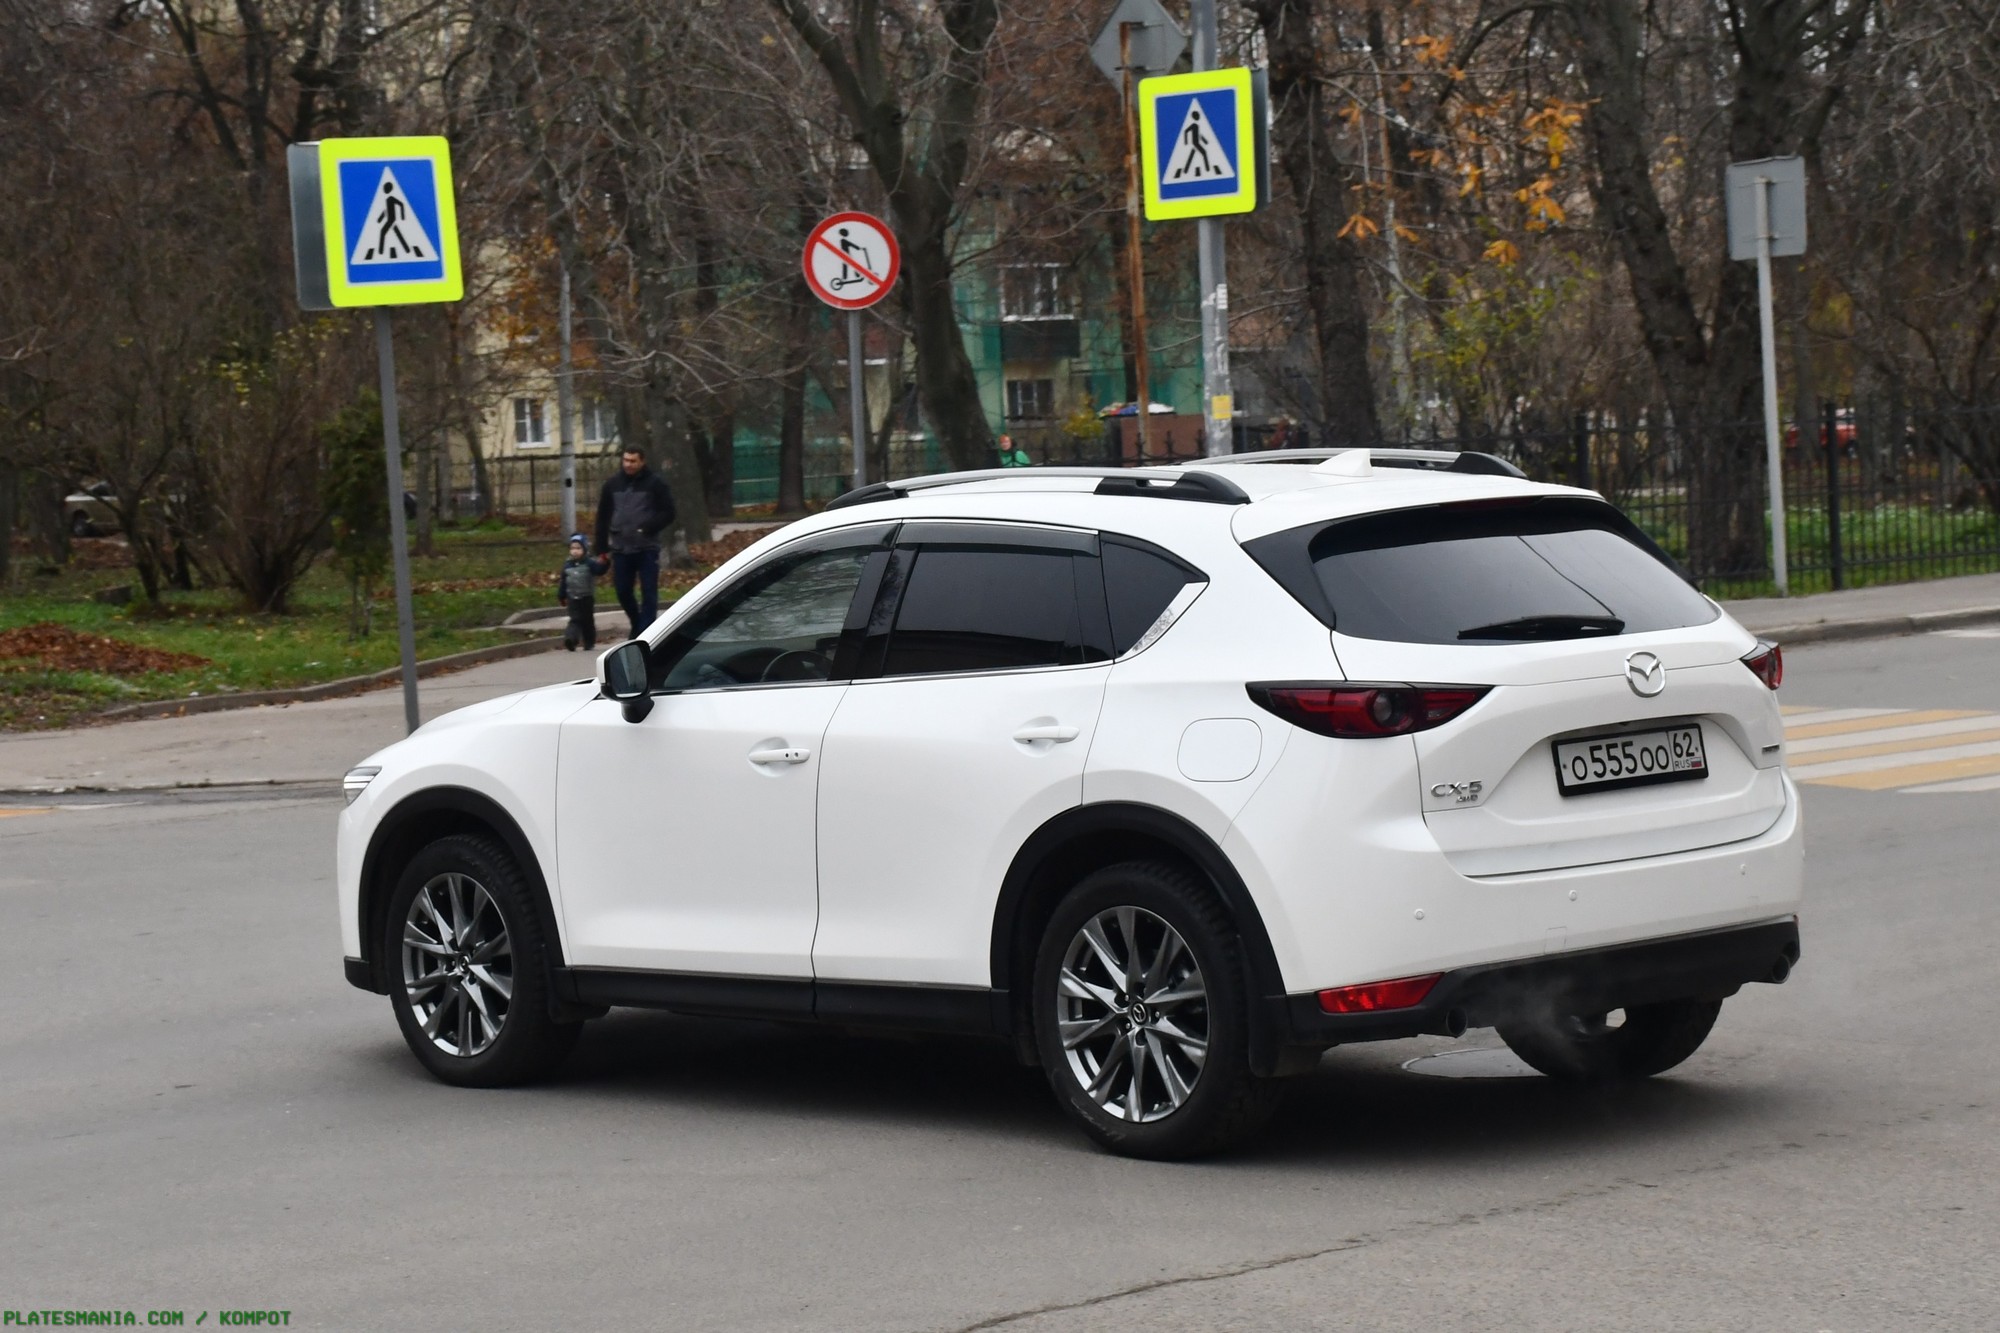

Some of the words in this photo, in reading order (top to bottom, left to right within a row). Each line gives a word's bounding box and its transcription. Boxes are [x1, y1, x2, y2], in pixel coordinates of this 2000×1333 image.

[1673, 732, 1695, 758] 62
[1675, 760, 1691, 769] RUS
[1431, 780, 1482, 798] CX-5
